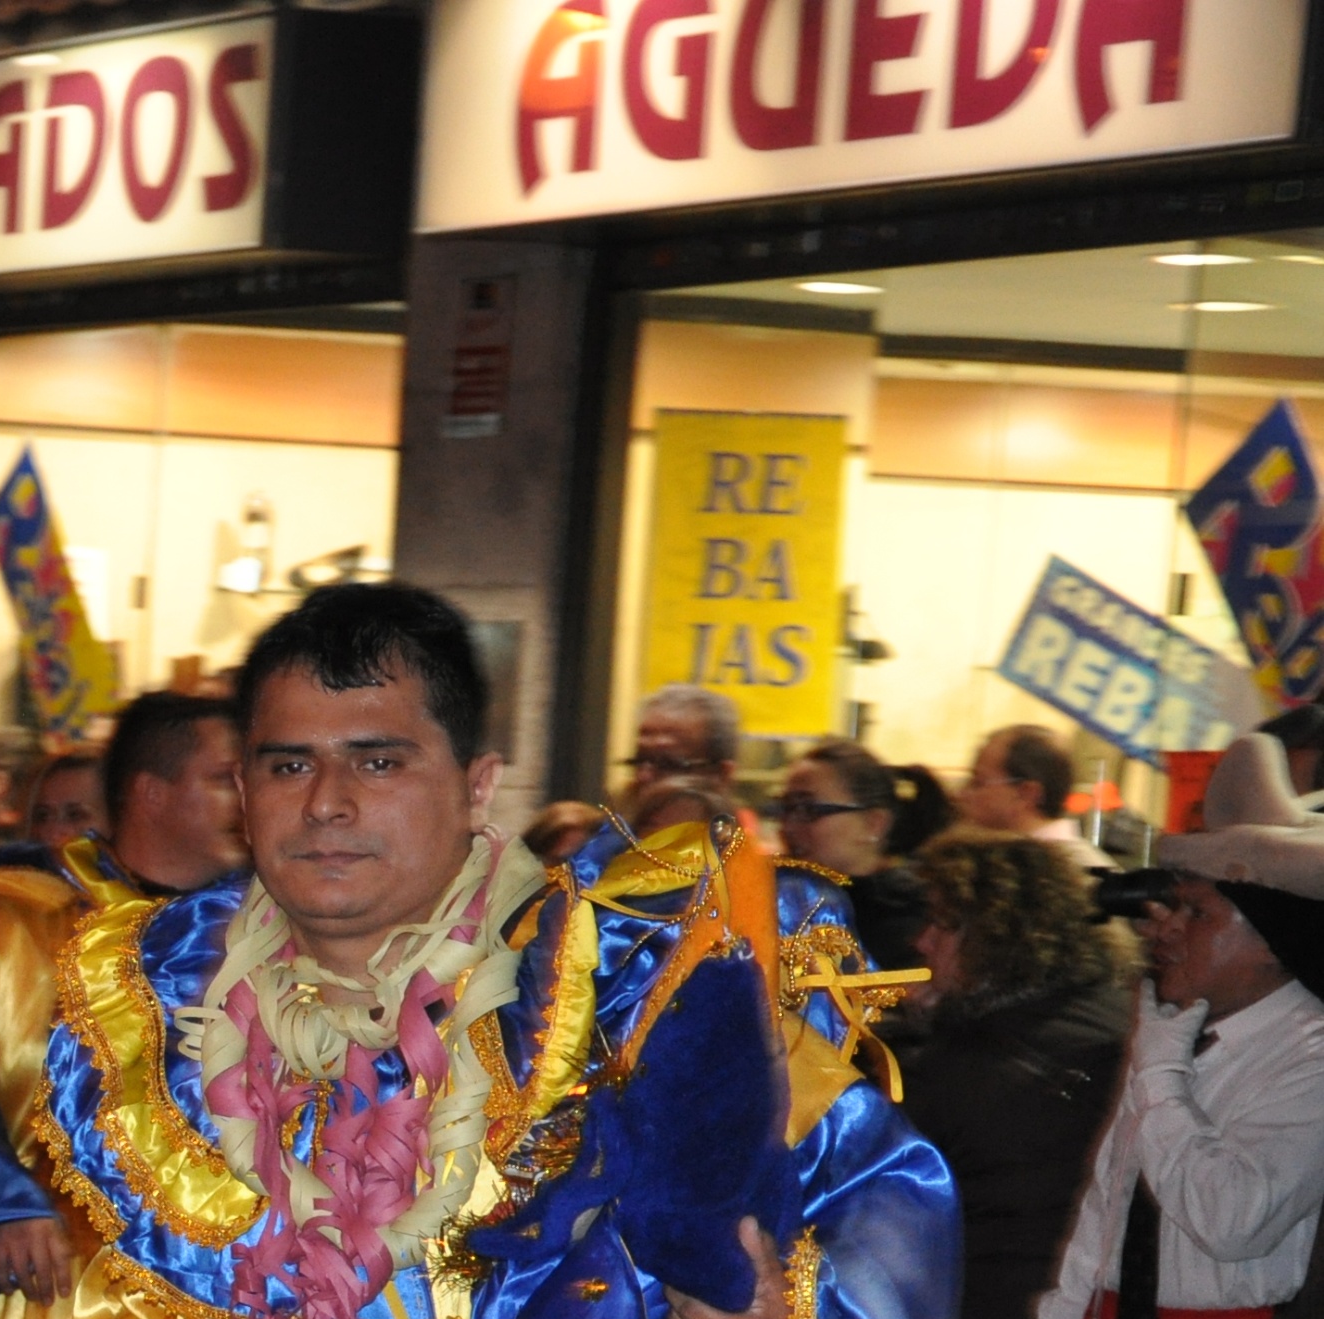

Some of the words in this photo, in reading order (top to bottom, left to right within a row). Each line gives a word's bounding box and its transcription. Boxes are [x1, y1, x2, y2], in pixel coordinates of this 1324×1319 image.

[517, 0, 1184, 200] AGUEDA
[698, 451, 808, 516] RE
[698, 537, 797, 601] BA
